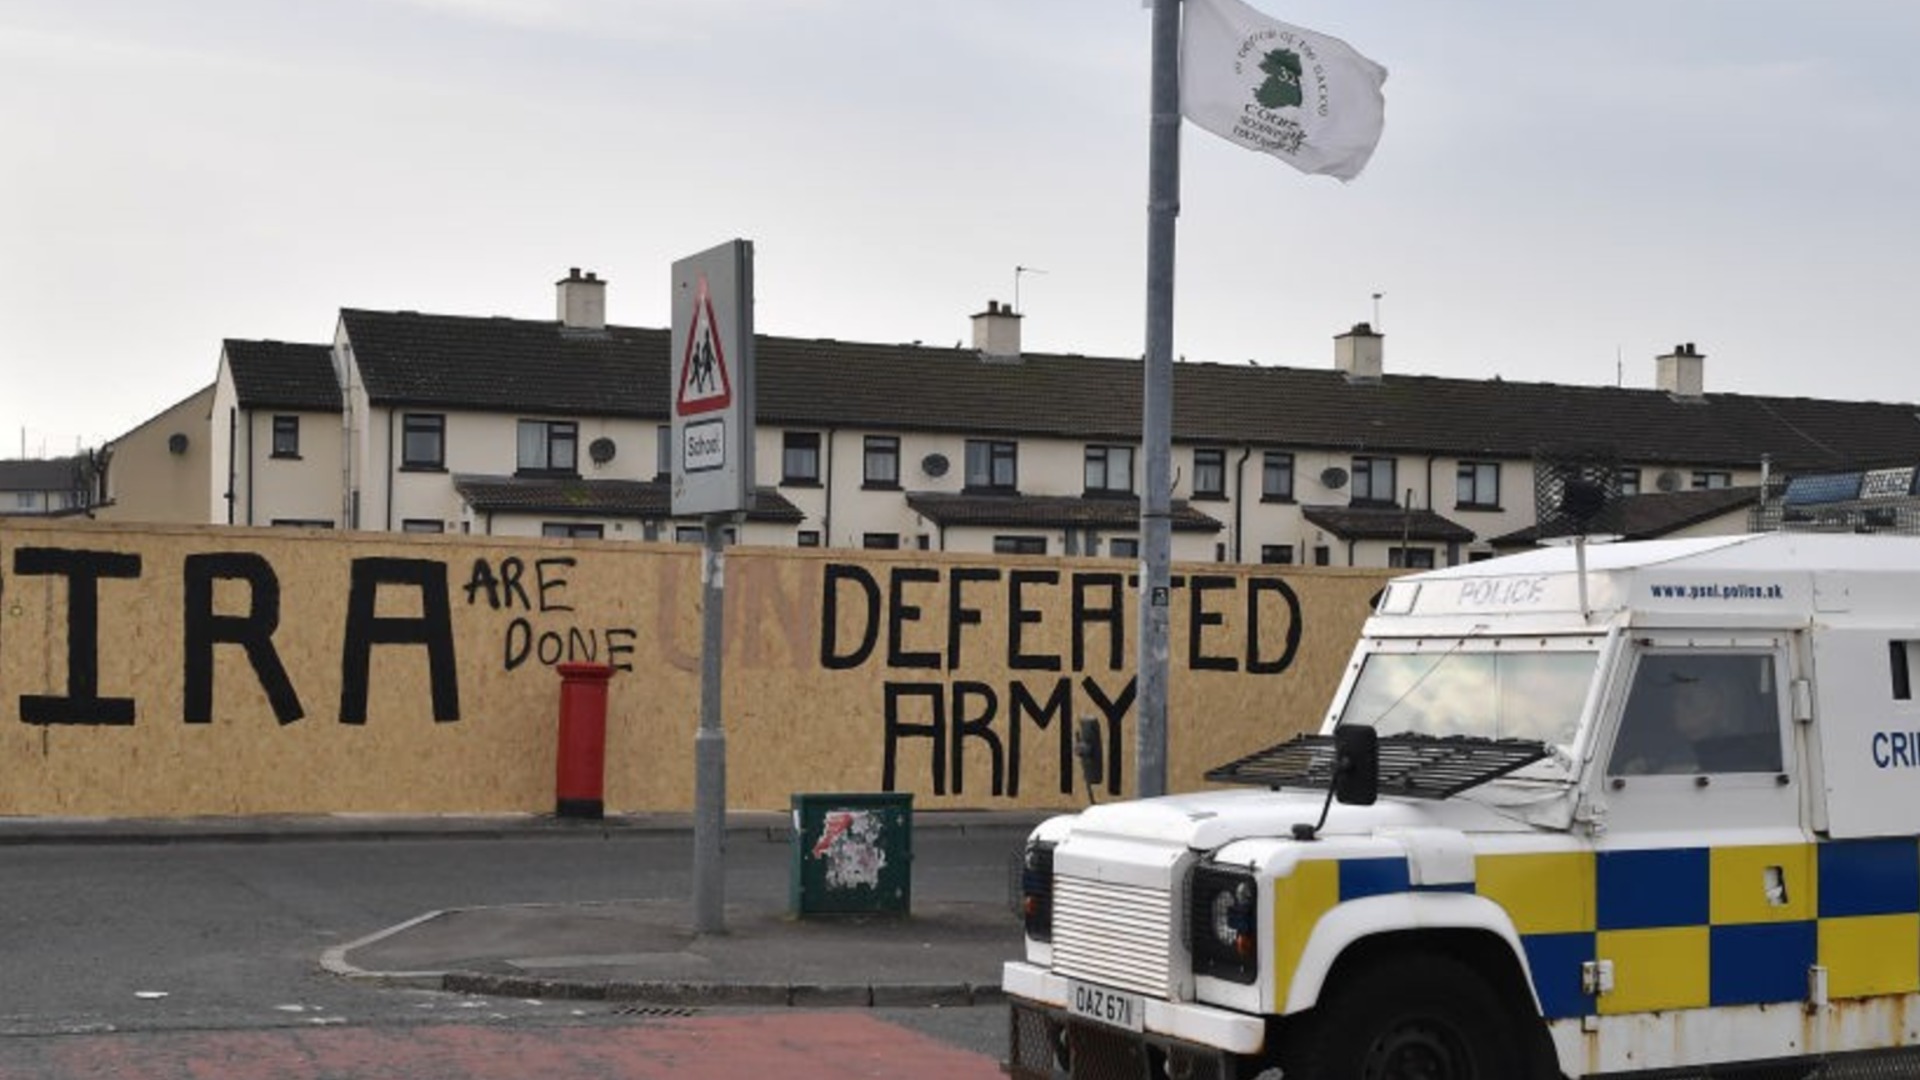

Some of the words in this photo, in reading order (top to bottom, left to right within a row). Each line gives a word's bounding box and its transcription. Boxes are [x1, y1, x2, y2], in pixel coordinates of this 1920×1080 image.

[687, 431, 721, 457] School
[463, 557, 577, 612] ARE
[1459, 577, 1548, 604] POLICE
[504, 617, 637, 671] DONE
[882, 676, 1138, 797] ARMY
[1872, 731, 1920, 768] CRI
[1076, 986, 1103, 1017] OAZ
